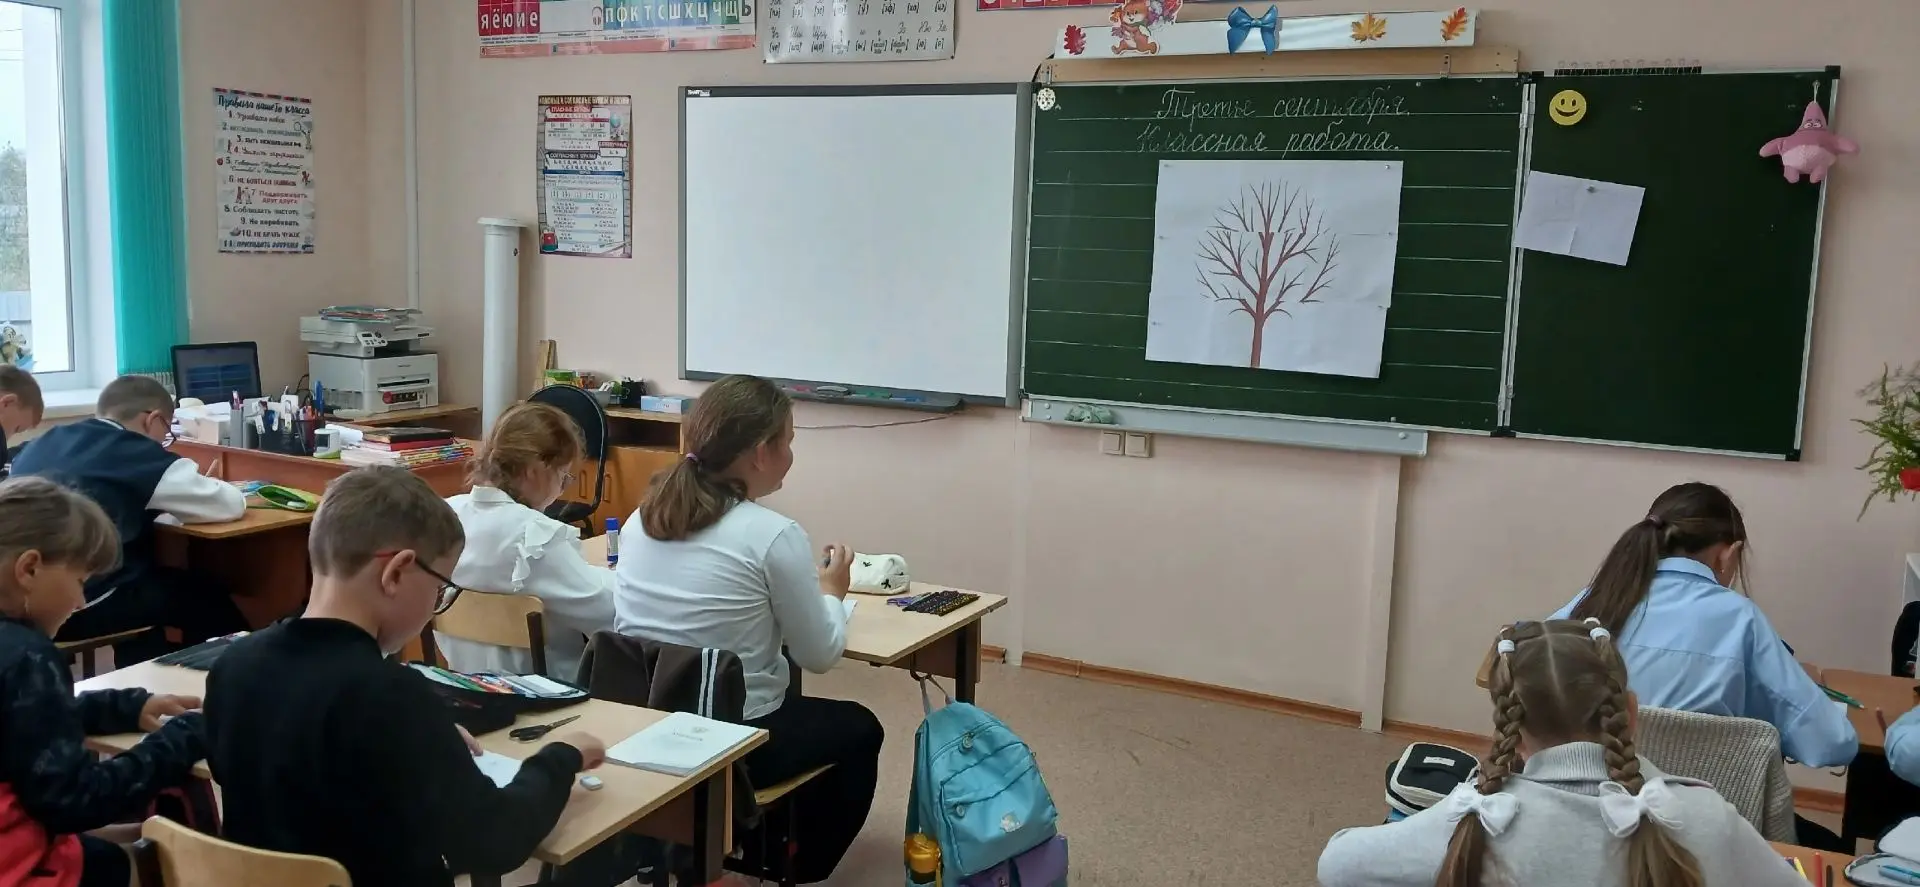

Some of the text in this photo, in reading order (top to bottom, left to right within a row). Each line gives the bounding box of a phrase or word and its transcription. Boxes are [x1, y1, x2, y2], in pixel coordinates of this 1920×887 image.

[218, 95, 310, 116] Правила нашего класса
[1282, 119, 1400, 159] работа.
